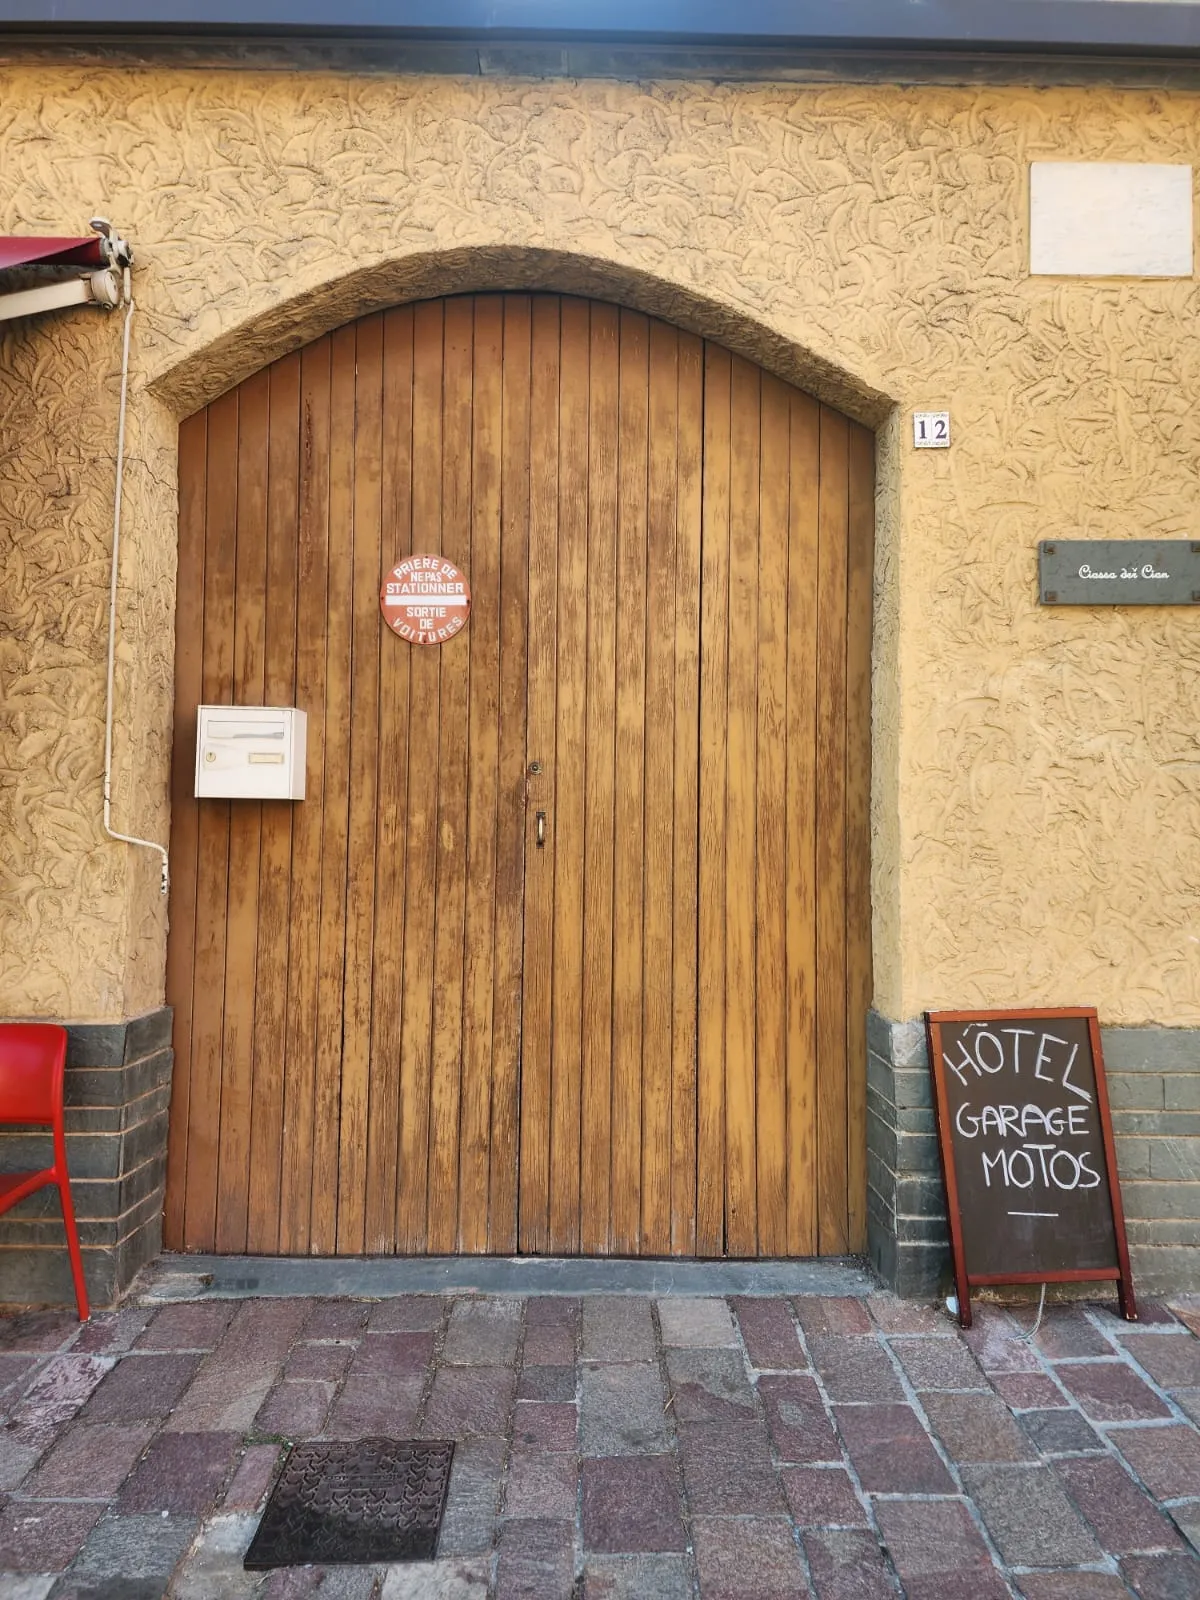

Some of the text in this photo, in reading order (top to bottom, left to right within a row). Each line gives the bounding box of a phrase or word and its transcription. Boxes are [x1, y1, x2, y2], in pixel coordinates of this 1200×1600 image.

[918, 420, 947, 439] 12
[411, 571, 442, 582] NE PAS
[441, 563, 458, 579] DE
[1079, 564, 1118, 579] Ciassa
[1141, 564, 1170, 579] Cian
[386, 582, 464, 593] STATIONNER
[406, 606, 447, 617] SORTIE
[392, 616, 463, 642] VOITURES
[419, 618, 433, 629] DE
[955, 1102, 1090, 1138] GARAGE
[981, 1143, 1101, 1190] MOTOS
